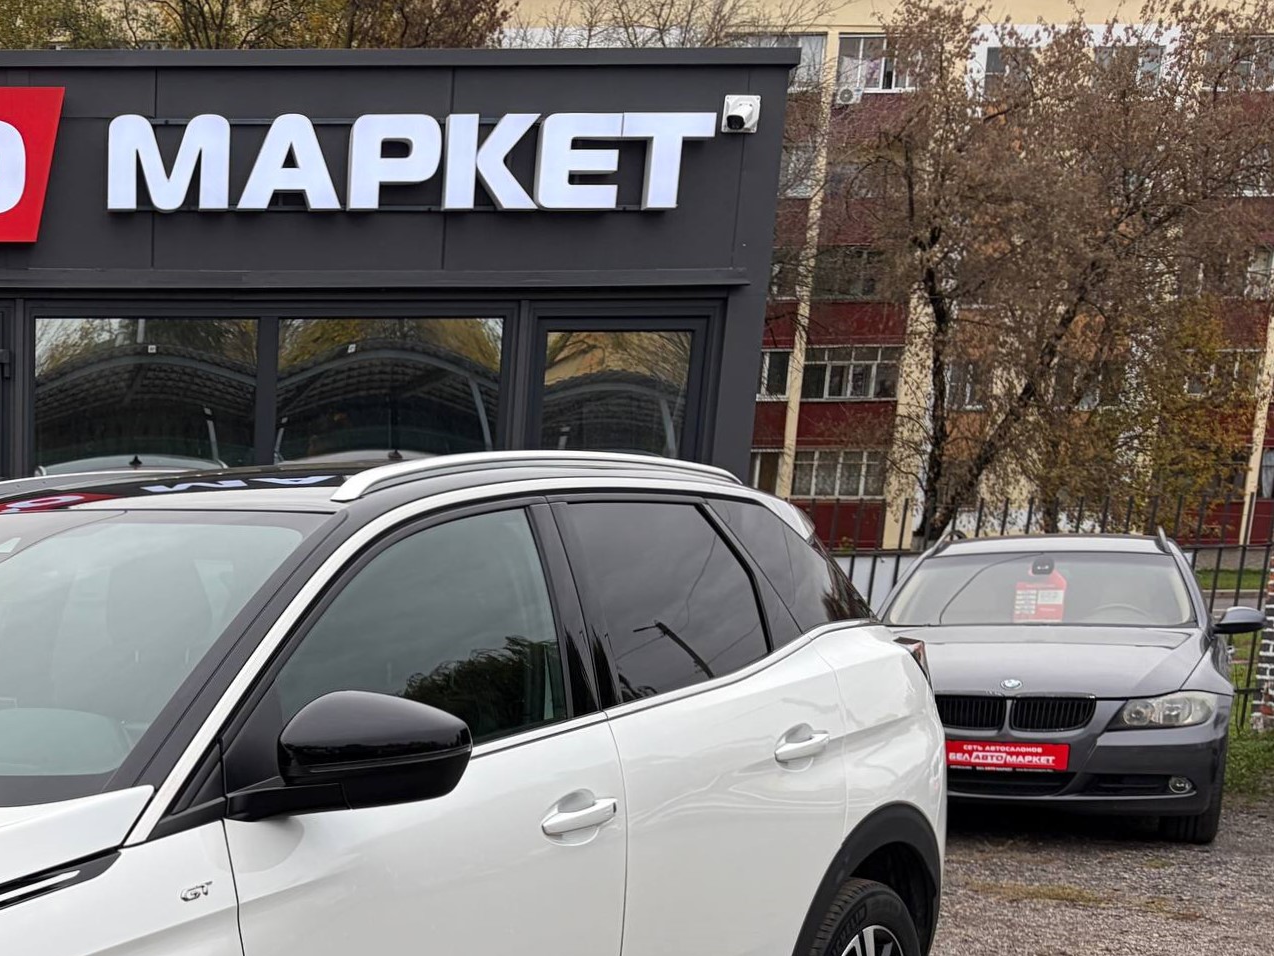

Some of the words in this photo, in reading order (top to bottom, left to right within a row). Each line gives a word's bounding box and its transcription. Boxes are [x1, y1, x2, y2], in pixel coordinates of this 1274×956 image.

[107, 112, 717, 213] МАРКЕТ
[962, 744, 984, 752] СЕТЬ
[984, 745, 1043, 754] АВТОСАЛОНОВ
[948, 752, 970, 761] БЕЛ
[972, 752, 1005, 763] АВТО
[1006, 754, 1055, 765] МАРКЕТ
[180, 881, 213, 902] GT
